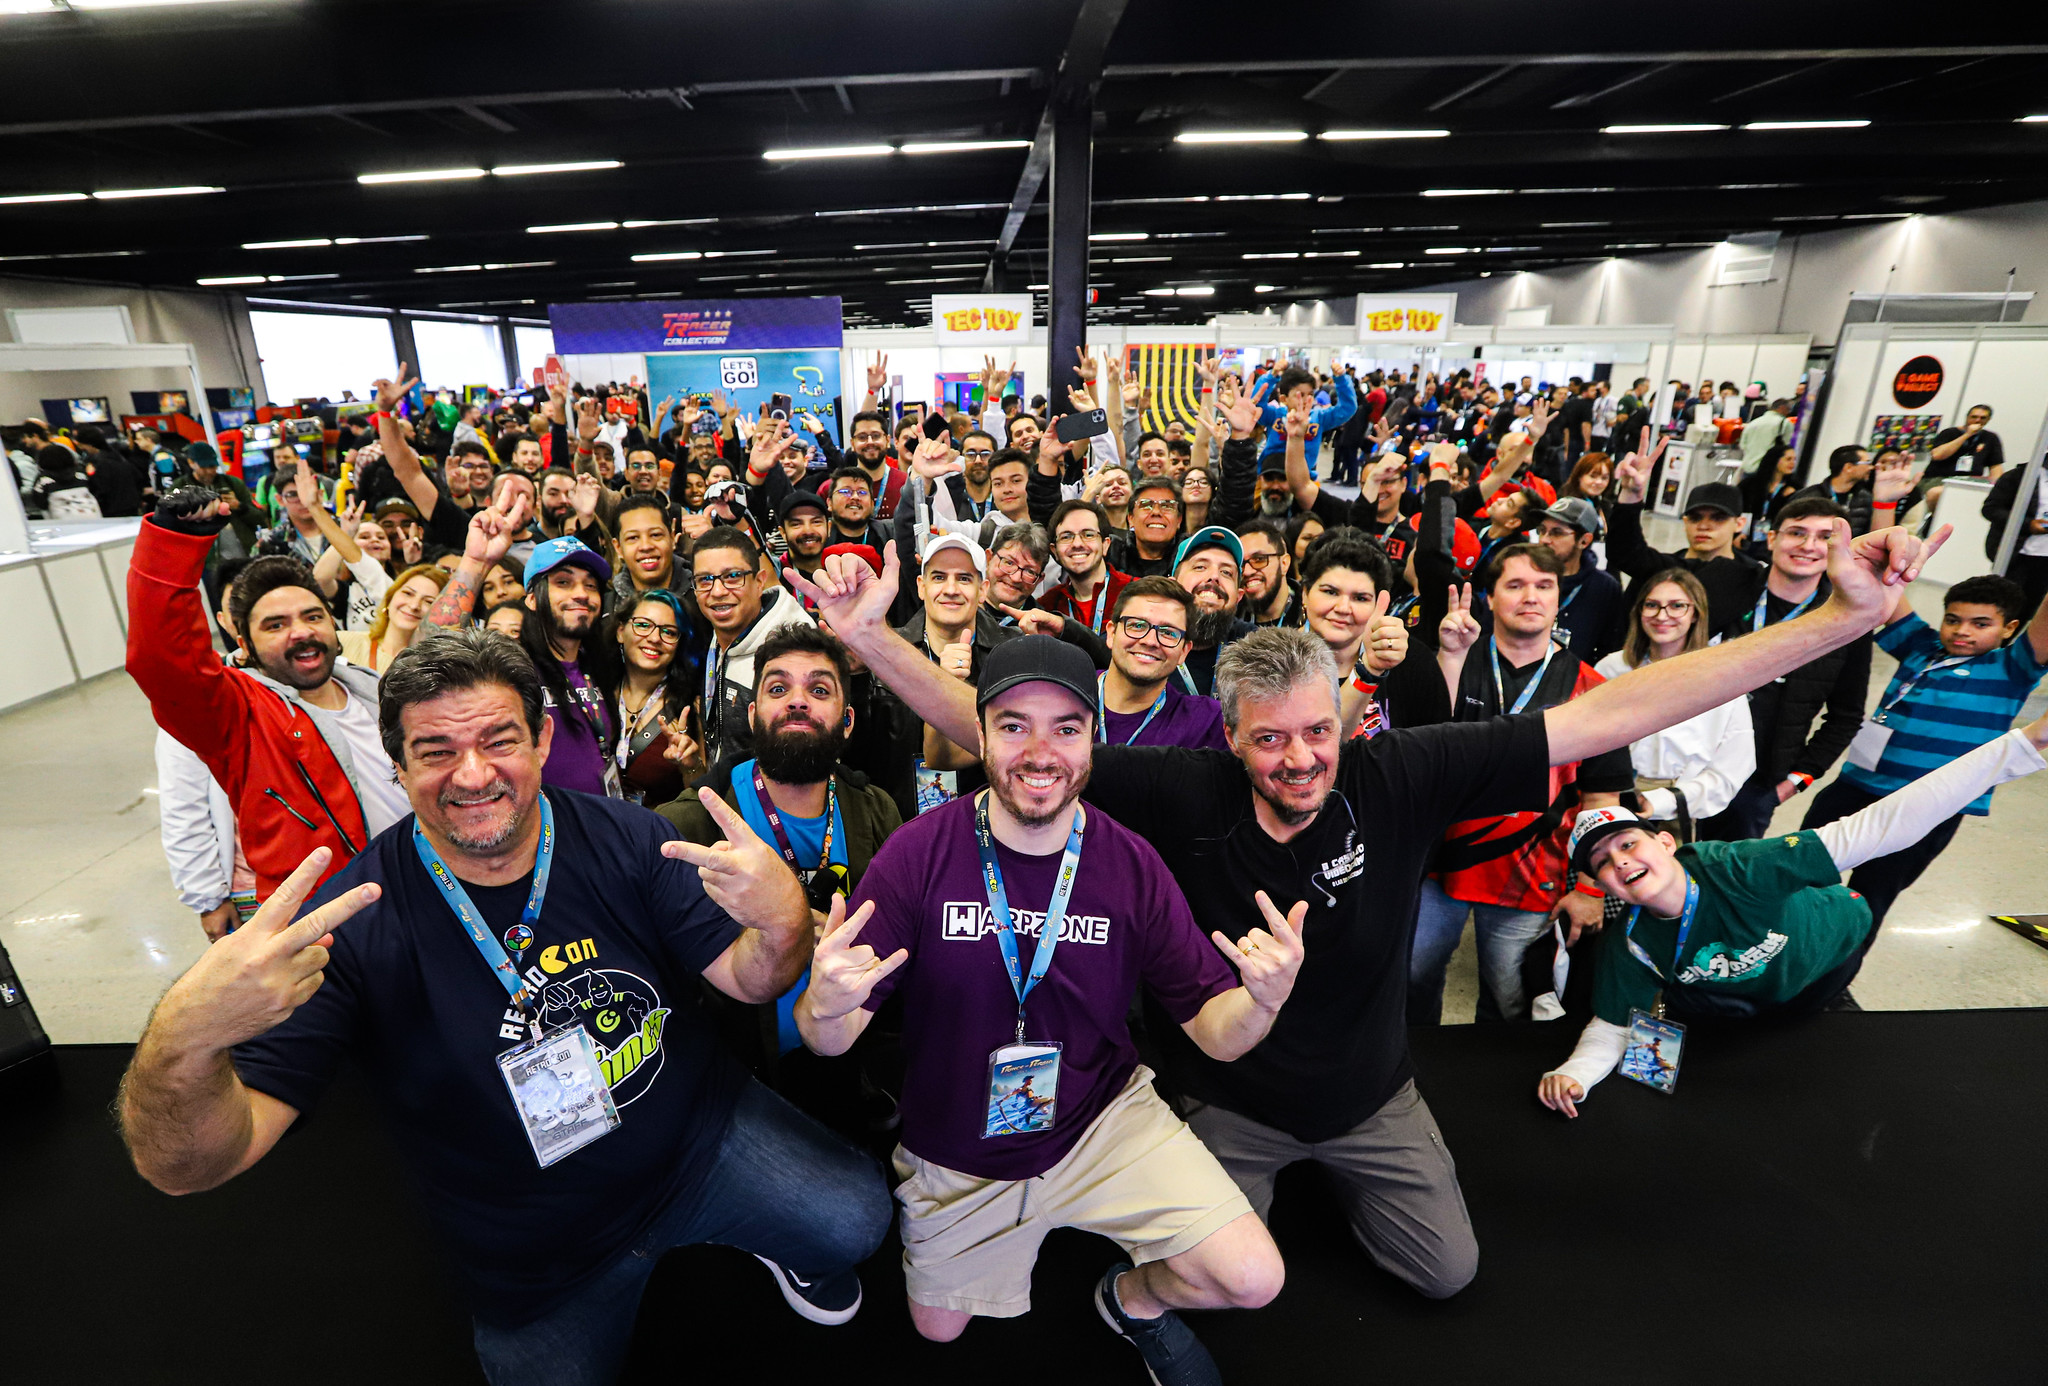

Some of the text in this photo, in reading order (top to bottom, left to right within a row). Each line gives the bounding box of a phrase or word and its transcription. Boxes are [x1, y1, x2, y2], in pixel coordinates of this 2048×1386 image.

[662, 312, 700, 328] TOP
[942, 308, 1023, 332] TEC TOY
[1366, 308, 1444, 332] TEC TOY
[667, 321, 732, 337] RACER
[663, 337, 727, 346] COLLECTION
[723, 361, 754, 370] LET'S
[547, 372, 560, 386] STO
[724, 371, 755, 384] GO!
[942, 901, 1111, 945] WARPZONE
[552, 1117, 589, 1141] STAFF
